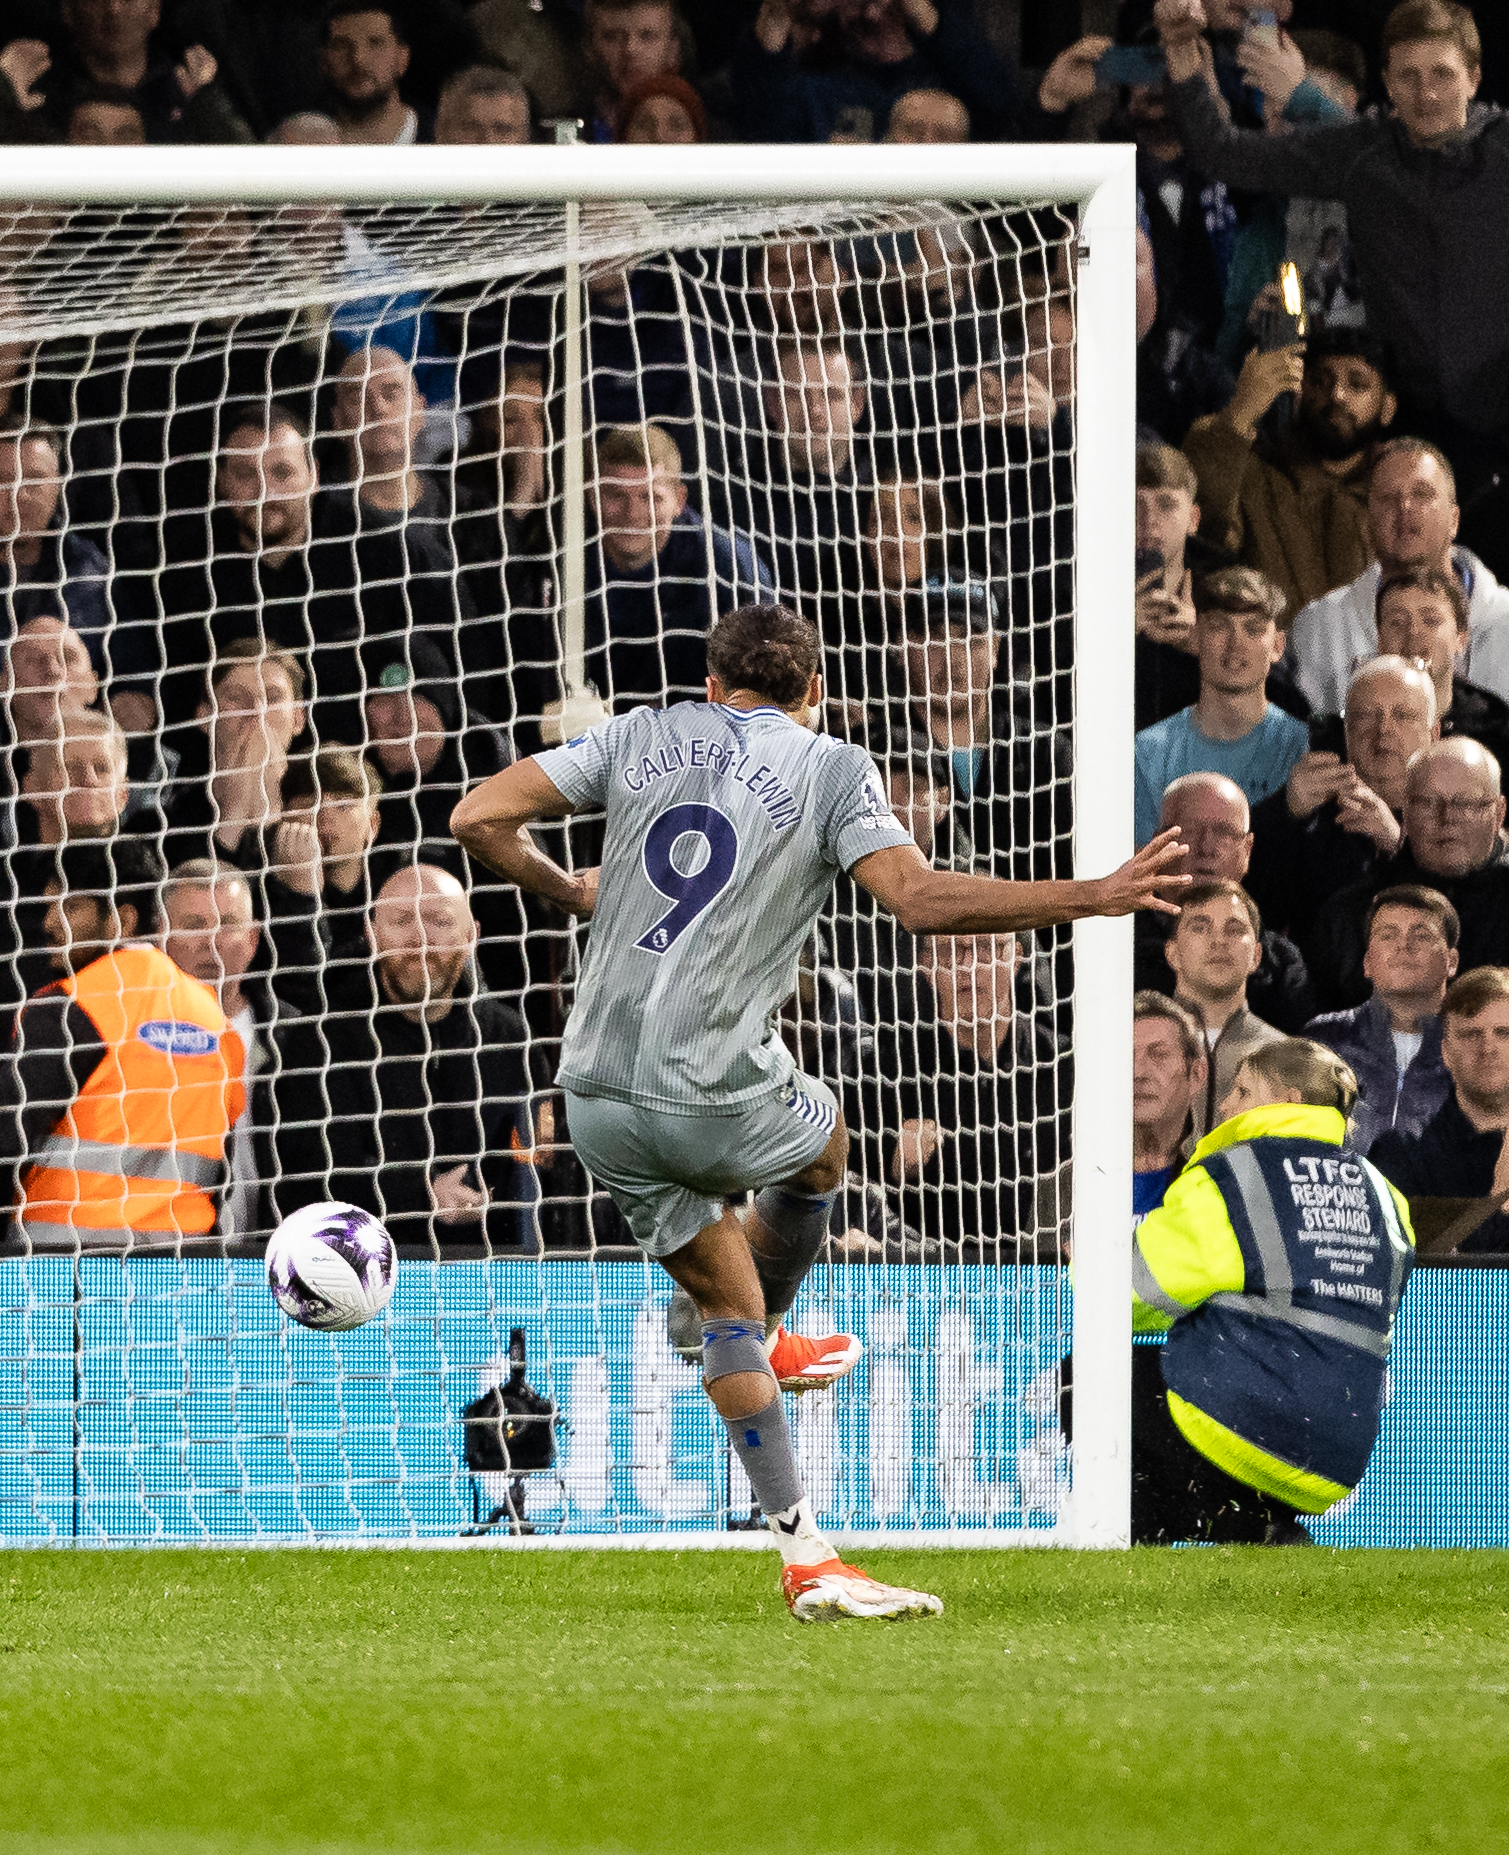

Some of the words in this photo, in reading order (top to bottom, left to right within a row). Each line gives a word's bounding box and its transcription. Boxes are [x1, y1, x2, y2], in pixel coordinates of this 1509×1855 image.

[633, 802, 738, 955] 9
[1283, 1156, 1363, 1185] LTFC
[1302, 1206, 1372, 1234] STEWARD
[1311, 1278, 1336, 1297] The
[1336, 1281, 1383, 1305] HATTERS
